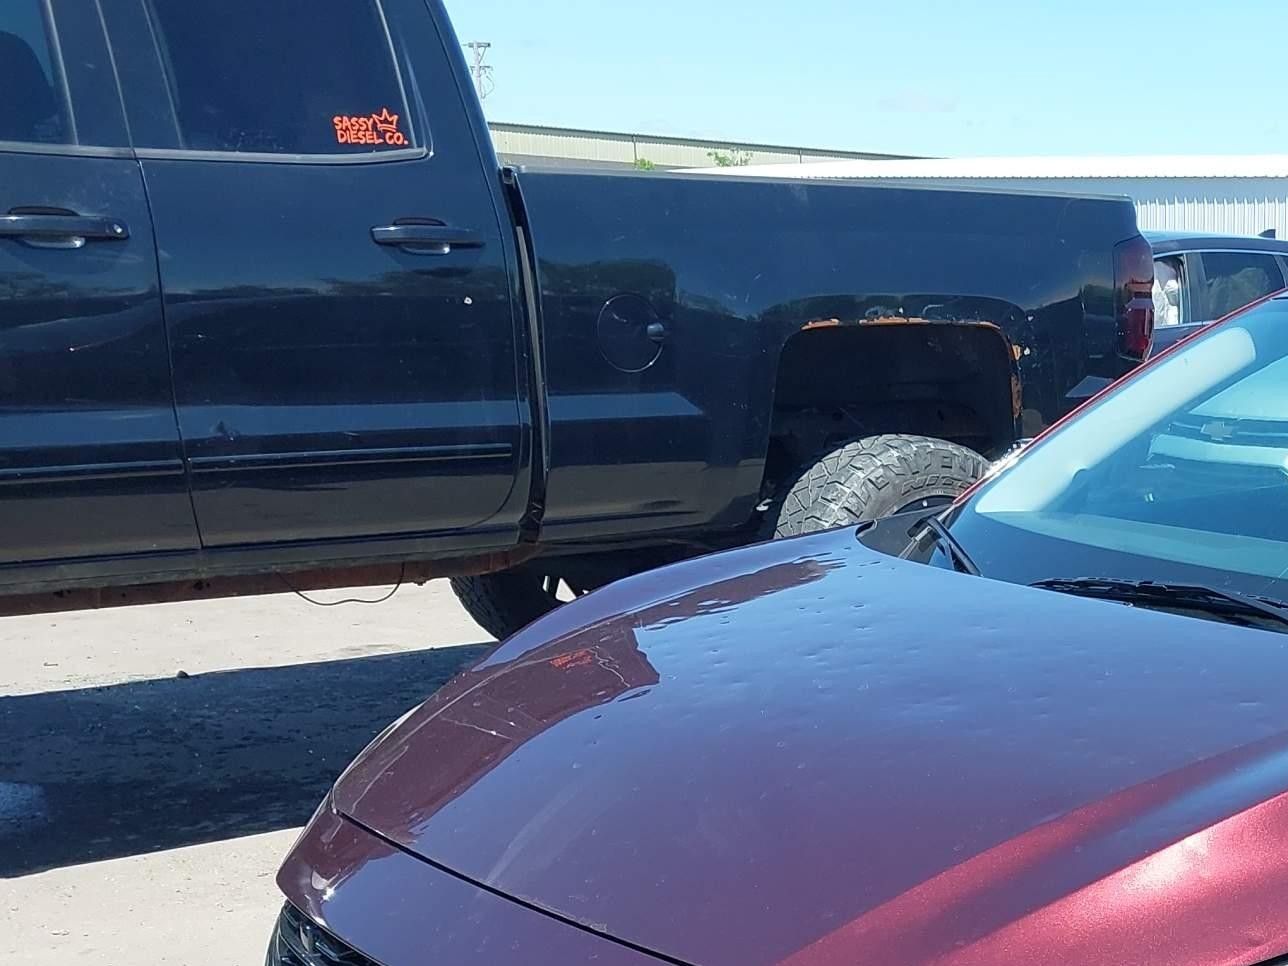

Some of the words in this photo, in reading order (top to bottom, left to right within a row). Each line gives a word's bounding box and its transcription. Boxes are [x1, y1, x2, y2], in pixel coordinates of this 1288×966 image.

[333, 116, 374, 130] SASSY
[337, 130, 384, 145] DIESEL
[385, 132, 409, 145] CO.
